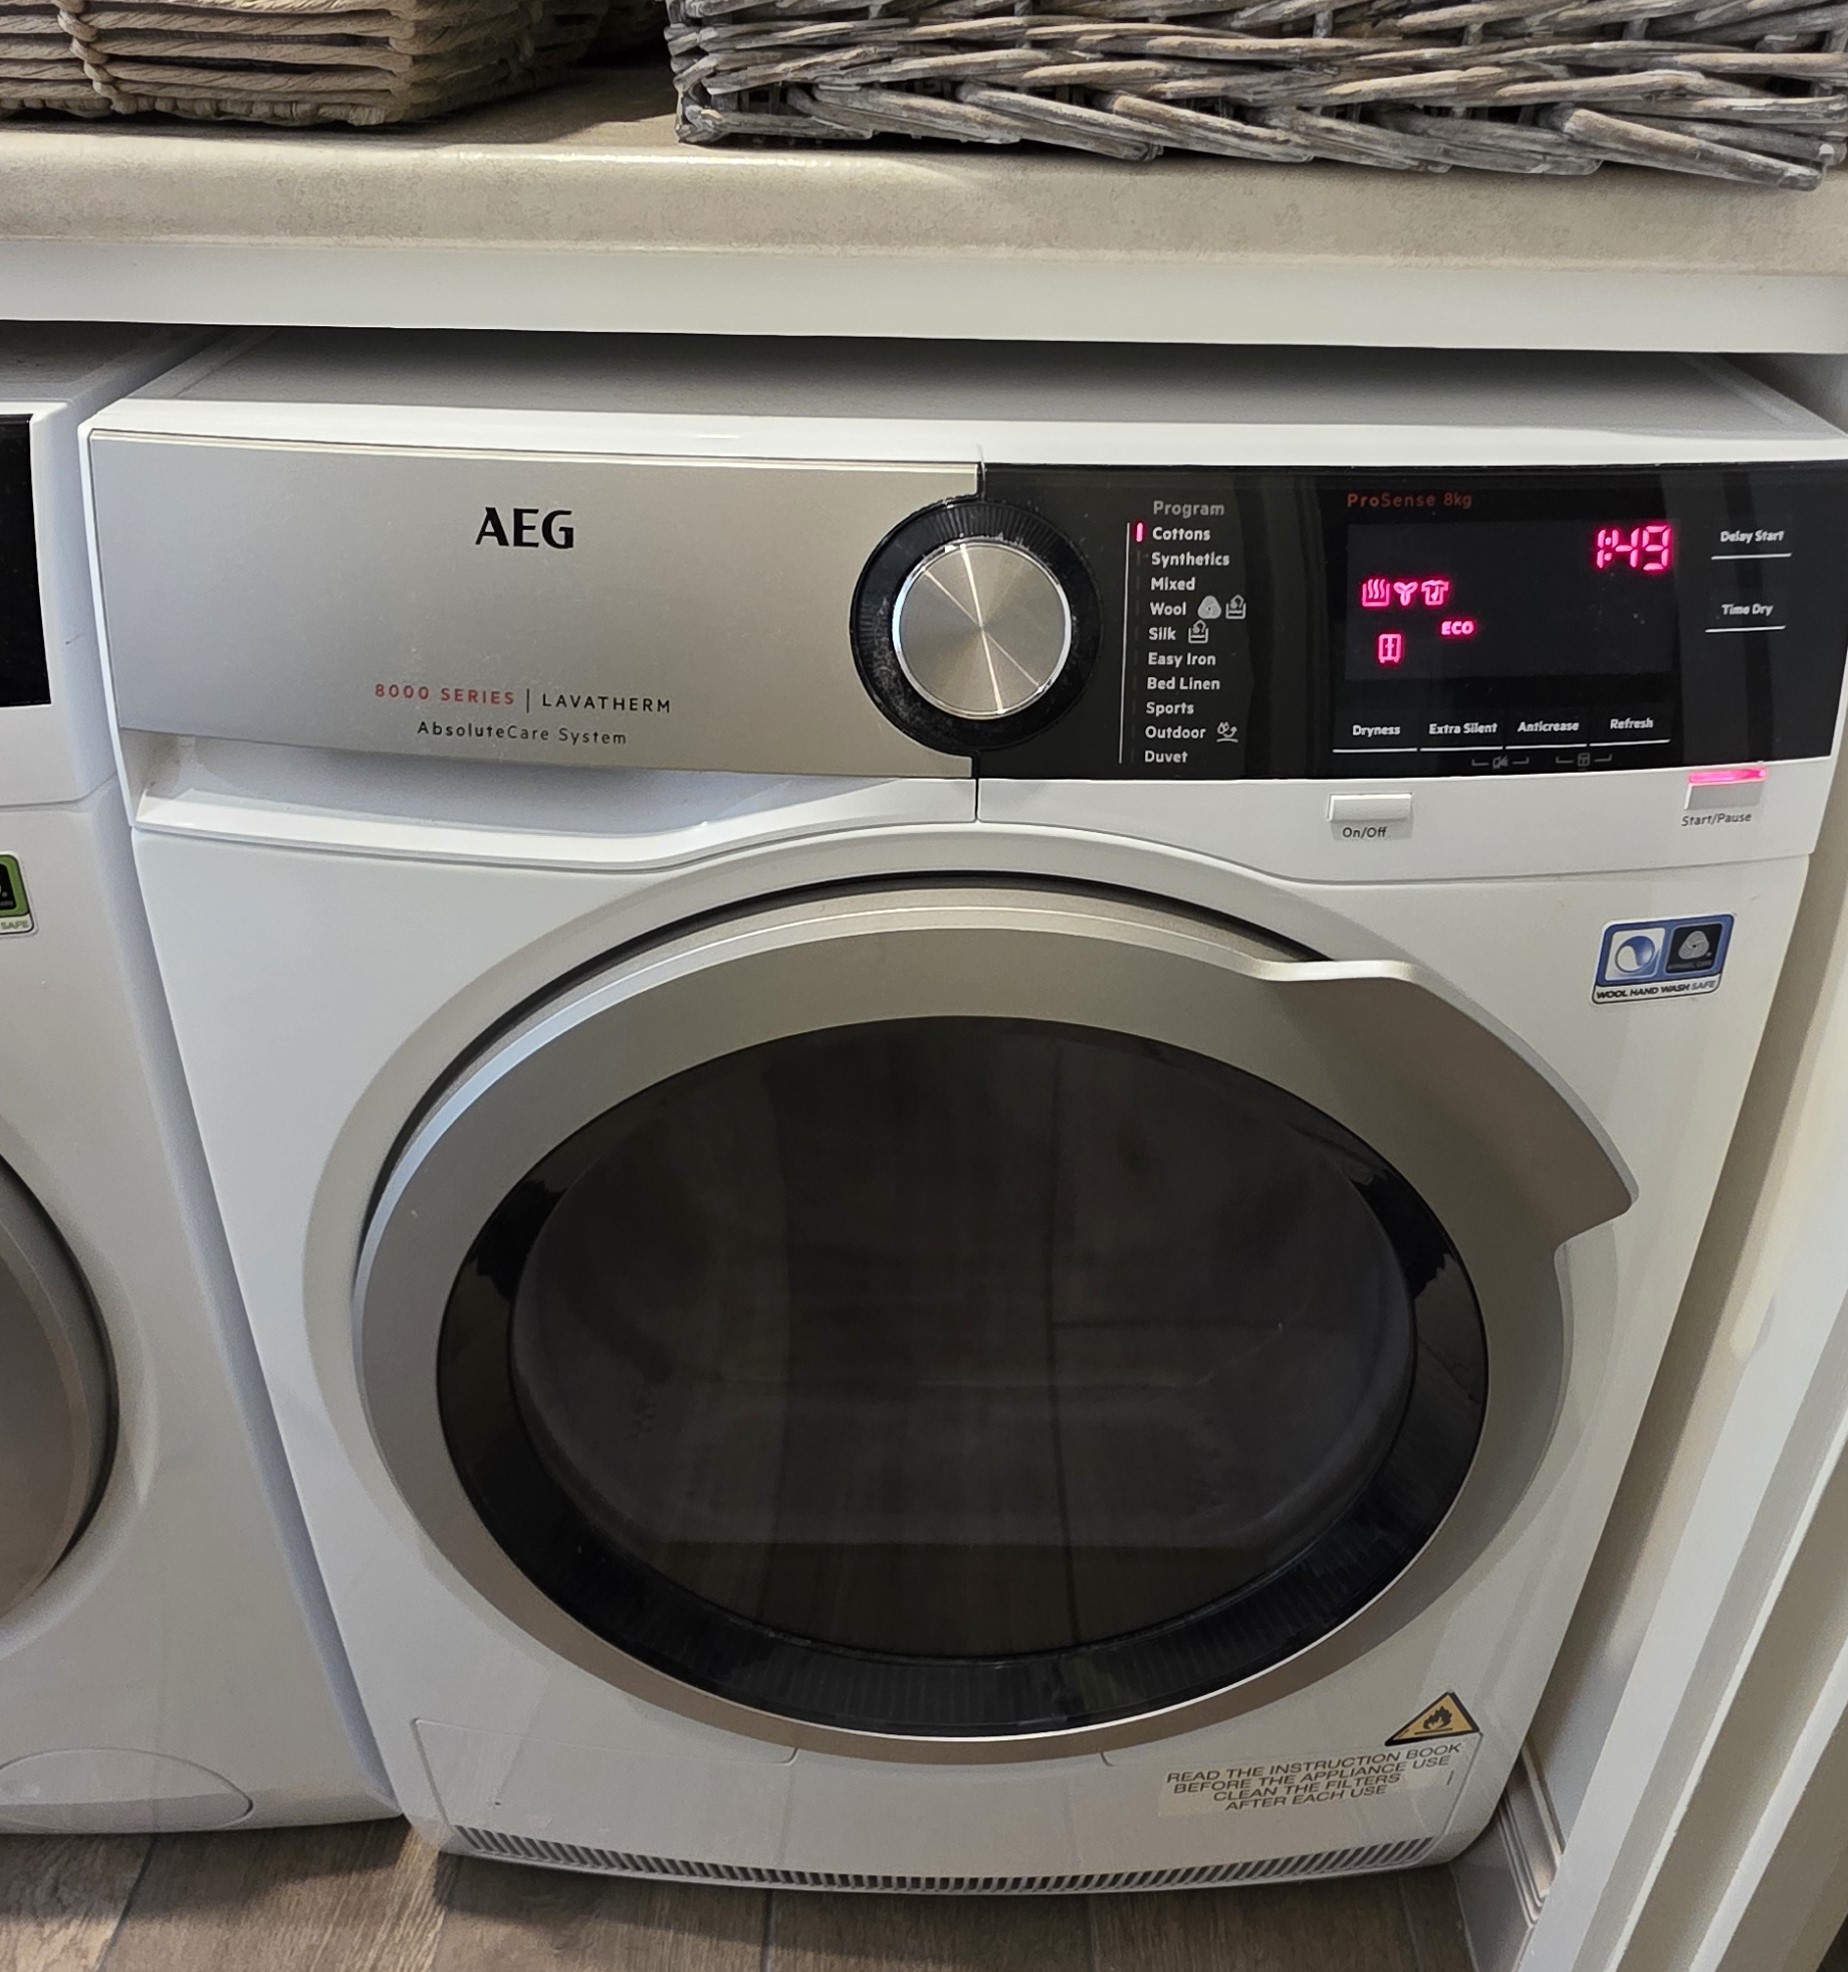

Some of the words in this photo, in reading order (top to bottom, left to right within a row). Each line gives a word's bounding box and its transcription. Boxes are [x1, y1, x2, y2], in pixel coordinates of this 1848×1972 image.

[1347, 493, 1435, 508] ProSense
[1444, 492, 1472, 509] 8kg
[1153, 501, 1225, 519] Program
[475, 506, 574, 549] AEG
[1152, 527, 1211, 541] Cottons
[1720, 531, 1753, 544] Delay
[1755, 530, 1785, 542] Start
[1596, 525, 1671, 571] 1:49
[1151, 552, 1230, 568] Synthetics
[1151, 577, 1195, 591] Mixed
[1150, 602, 1186, 616] Wool
[1722, 604, 1750, 615] Time
[1752, 603, 1774, 616] Dry
[1149, 627, 1176, 640] Silk
[1441, 621, 1474, 635] ECO
[1148, 653, 1181, 668] Easy
[1187, 653, 1216, 665] Iron
[1147, 677, 1175, 690] Bed
[1180, 677, 1220, 690] Linen
[375, 684, 430, 700] 8000
[441, 688, 515, 705] SERIES
[542, 693, 671, 713] LAVATHERM
[1146, 702, 1194, 717] Sports
[1353, 724, 1400, 737] Dryness
[1429, 723, 1460, 735] Extra
[1463, 722, 1498, 734] Silent
[1517, 720, 1579, 732] Anticrease
[1610, 717, 1654, 730] Refresh
[417, 721, 550, 742] AbsoluteCare
[559, 728, 627, 746] System
[1145, 726, 1206, 740] Outdoor
[1144, 750, 1188, 763] Duvet
[1681, 811, 1752, 827] Start/Pause
[1342, 827, 1387, 839] On/Off
[1, 920, 29, 930] SAFE
[1596, 990, 1628, 999] WOOL
[1630, 987, 1659, 996] HAND
[1661, 984, 1690, 993] WASH
[1691, 980, 1717, 991] SAFE
[1167, 1770, 1220, 1783] READ
[1226, 1767, 1264, 1779] THE
[1270, 1751, 1401, 1775] INSTRUCTION
[1406, 1743, 1462, 1760] BOOK
[1173, 1780, 1250, 1794] BEFORE
[1258, 1775, 1295, 1787] THE
[1300, 1761, 1406, 1783] APPLIANCE
[1412, 1755, 1450, 1770] USE
[1213, 1787, 1278, 1802] CLEAN
[1285, 1783, 1319, 1795] THE
[1326, 1773, 1401, 1791] FILTERS
[1225, 1797, 1286, 1811] AFTER
[1292, 1790, 1345, 1805] EACH
[1350, 1785, 1387, 1799] USE
